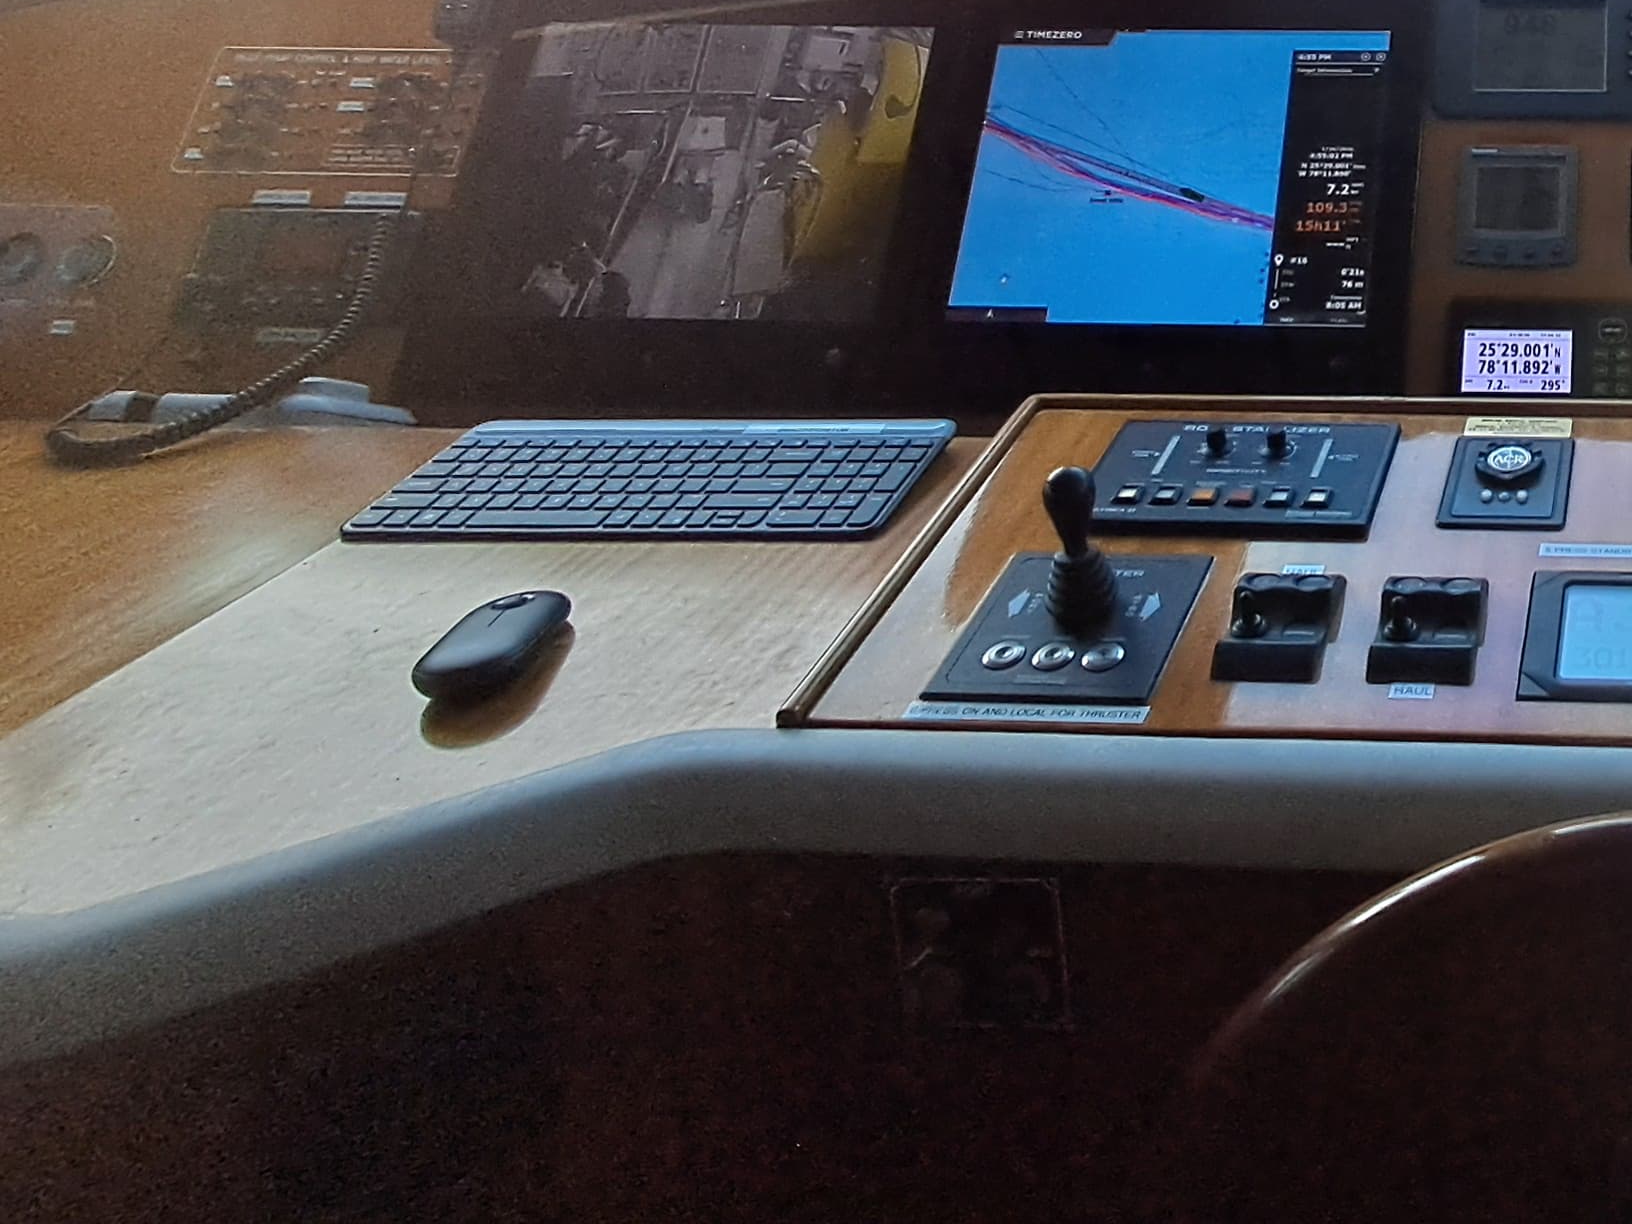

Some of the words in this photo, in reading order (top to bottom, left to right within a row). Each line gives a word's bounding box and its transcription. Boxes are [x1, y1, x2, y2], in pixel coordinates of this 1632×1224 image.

[1027, 30, 1082, 39] TIMEZERO
[1327, 183, 1350, 195] 7.2
[1306, 202, 1348, 213] 109.3
[1347, 301, 1362, 309] AM
[1554, 347, 1561, 357] N
[1487, 379, 1503, 390] 7.2
[1494, 455, 1524, 465] ACR
[1394, 687, 1433, 696] HAUL
[981, 707, 1009, 716] AND
[1009, 708, 1046, 717] LOCAL
[1079, 710, 1142, 719] THRUSTER
